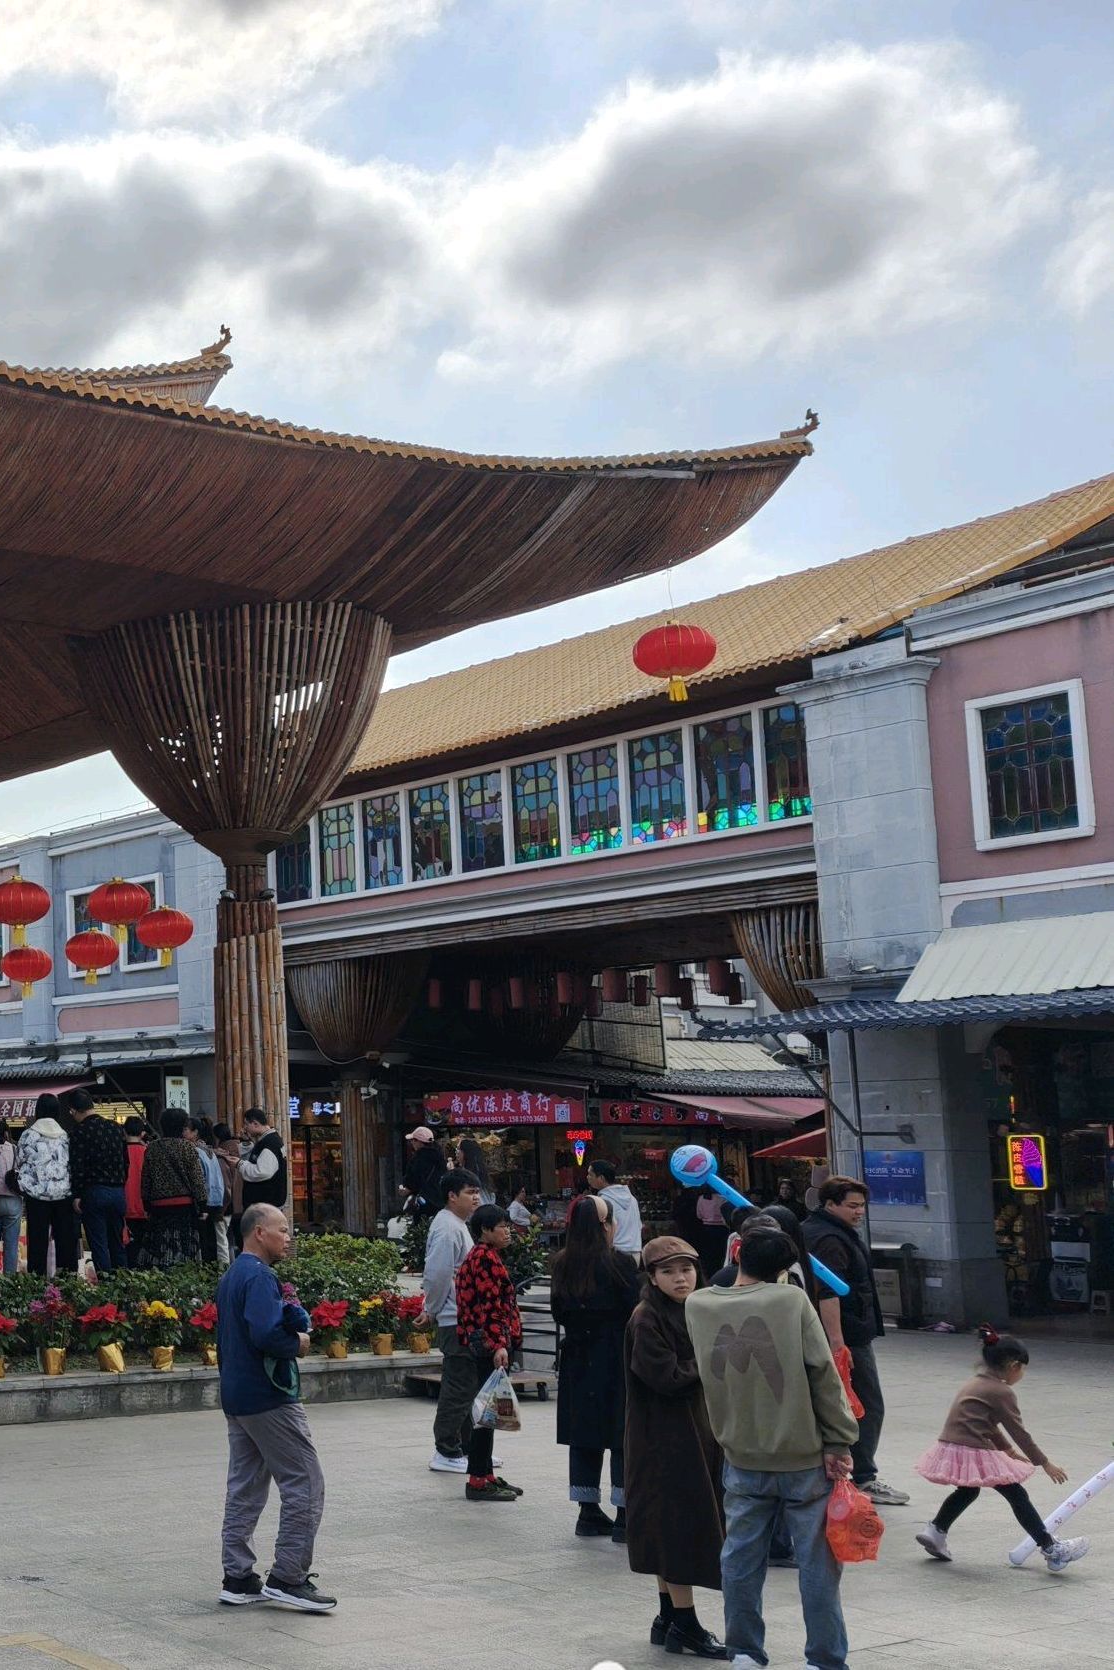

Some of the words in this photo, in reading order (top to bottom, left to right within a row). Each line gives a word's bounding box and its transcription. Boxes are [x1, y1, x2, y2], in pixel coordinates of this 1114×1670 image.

[450, 1091, 551, 1114] 尚优陈皮商行
